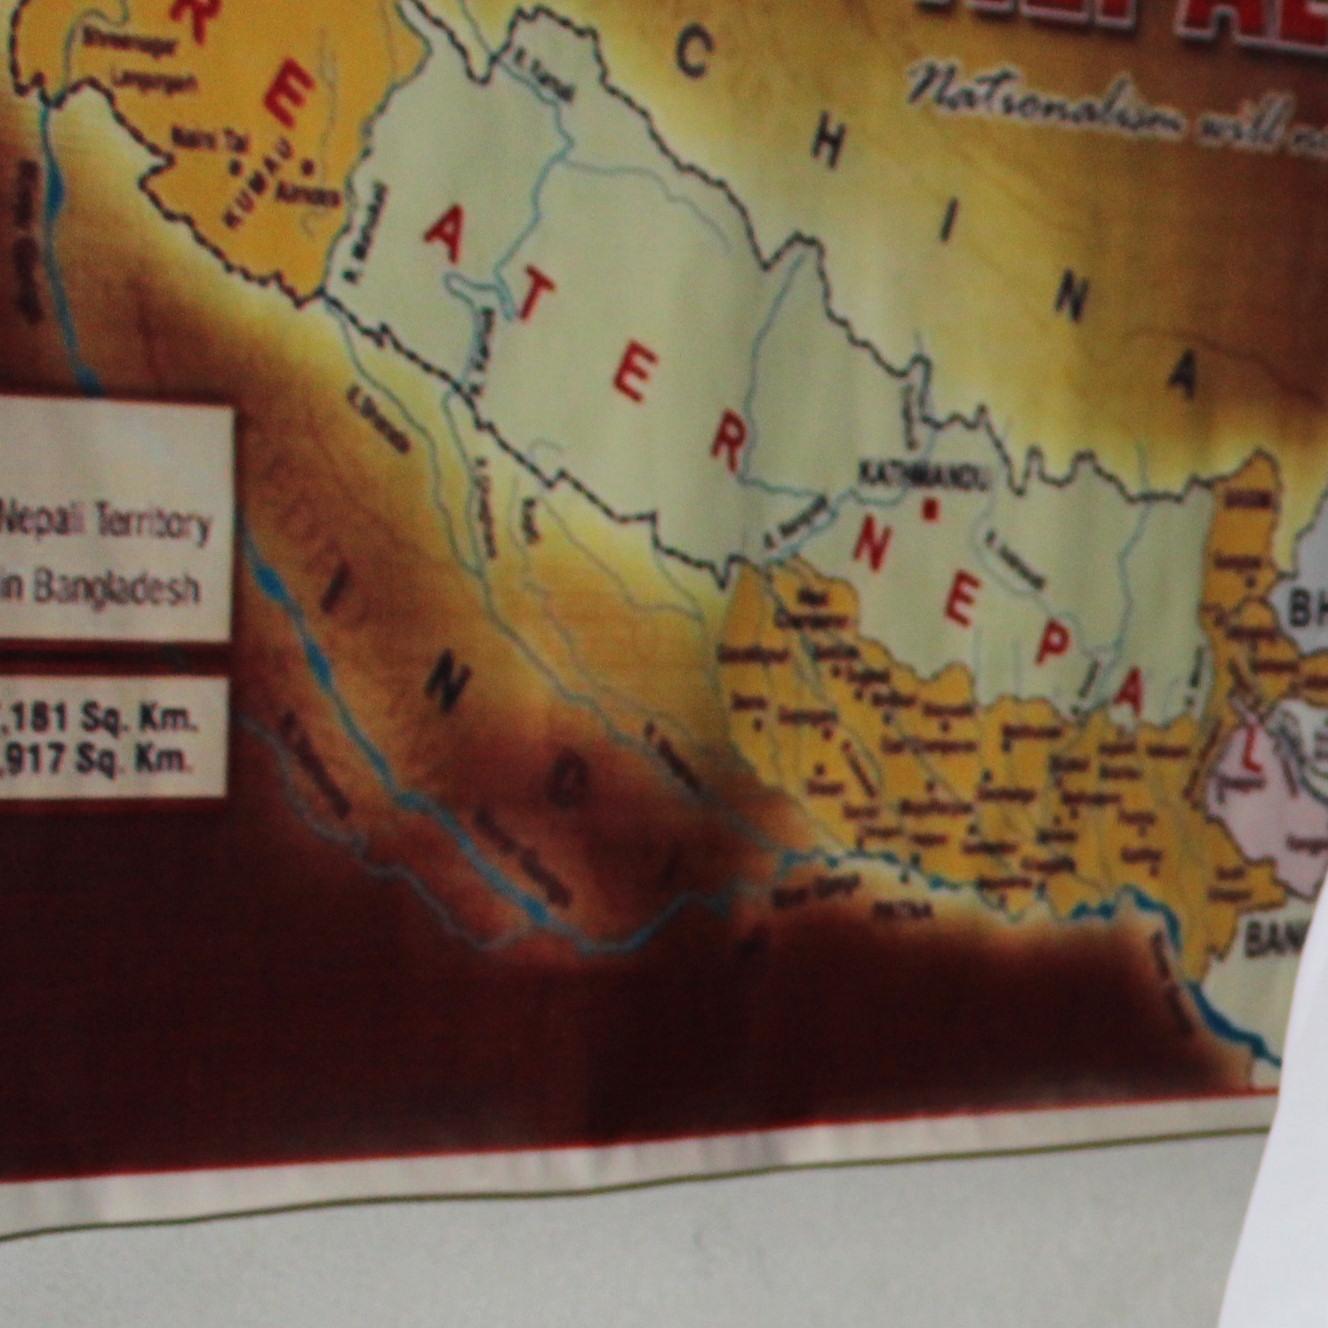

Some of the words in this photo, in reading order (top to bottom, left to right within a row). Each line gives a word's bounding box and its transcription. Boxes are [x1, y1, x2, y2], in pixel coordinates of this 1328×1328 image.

[95, 499, 212, 549] Territory
[33, 567, 201, 612] Bangladesh
[81, 702, 129, 738] Sq.
[139, 702, 199, 733] Km.
